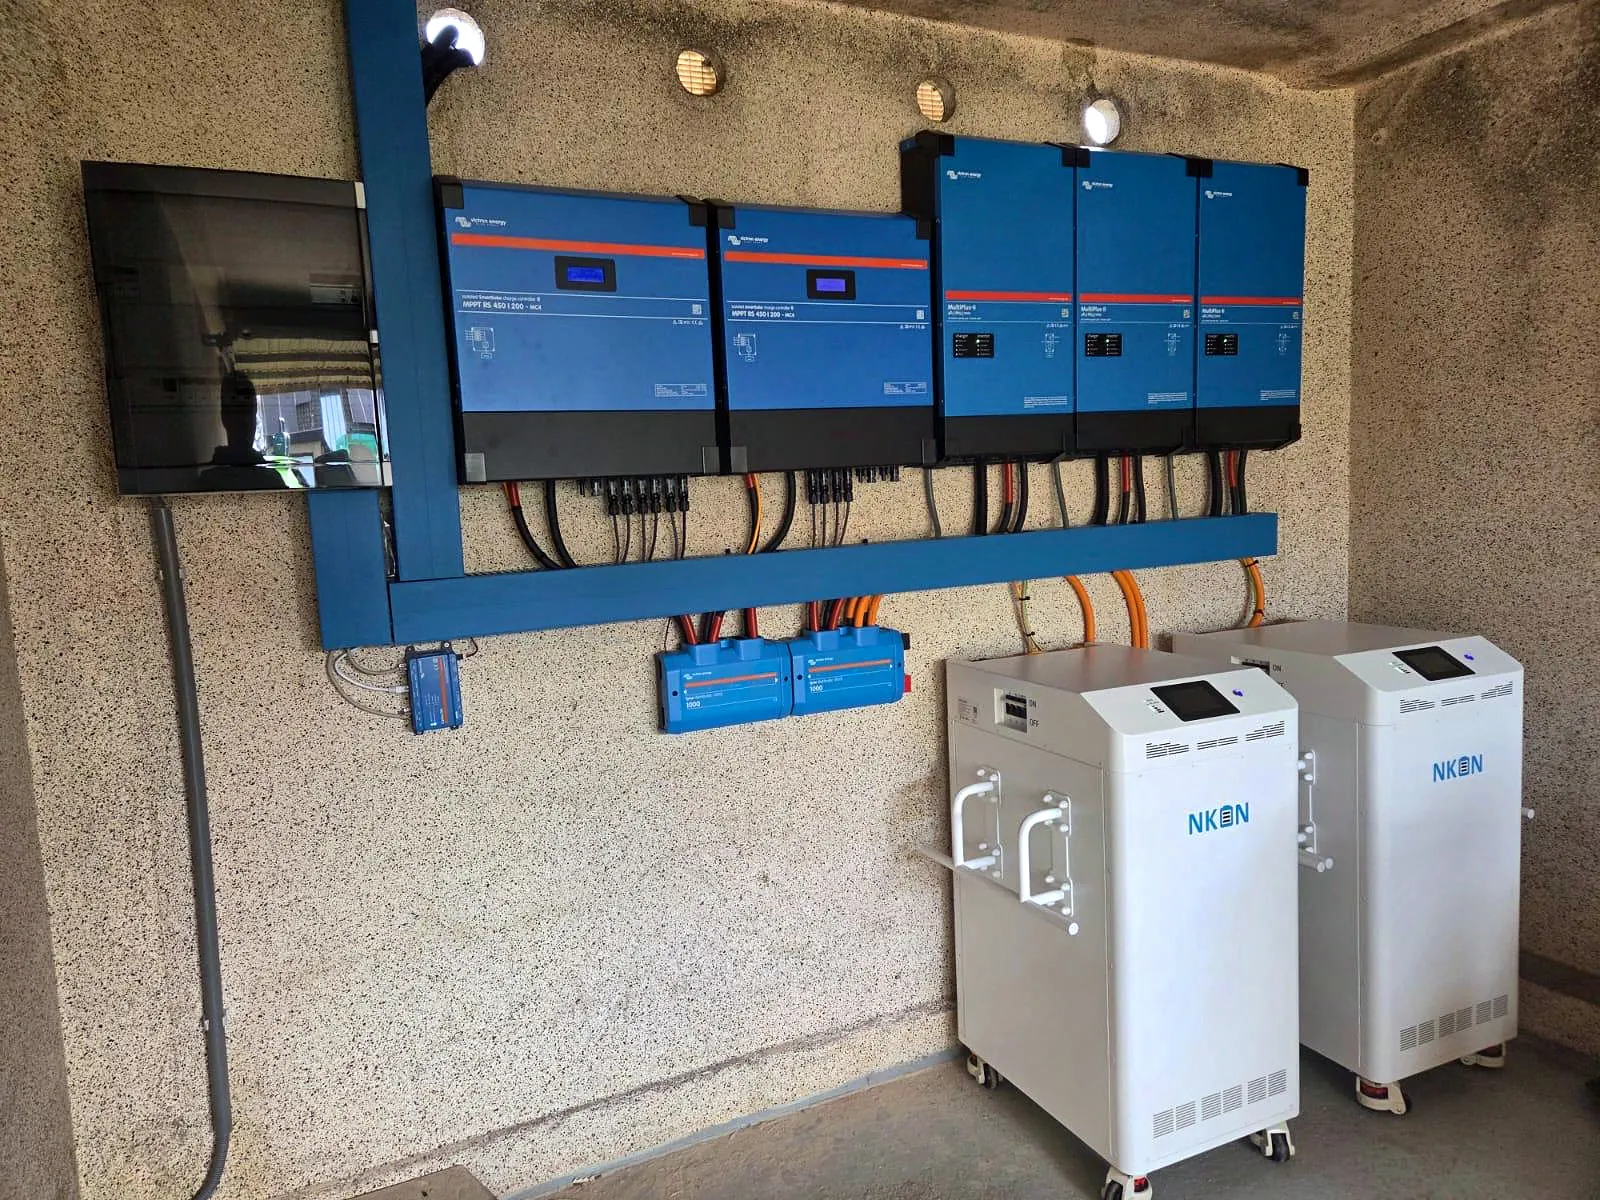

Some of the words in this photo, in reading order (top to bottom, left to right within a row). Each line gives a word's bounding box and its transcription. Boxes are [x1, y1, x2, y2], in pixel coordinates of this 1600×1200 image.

[1272, 664, 1282, 672] ON
[810, 684, 824, 692] 1000
[686, 700, 700, 708] 1000
[1030, 698, 1036, 708] ON
[1030, 719, 1040, 728] OFF
[1433, 754, 1482, 783] NKON
[1188, 802, 1249, 835] NKON
